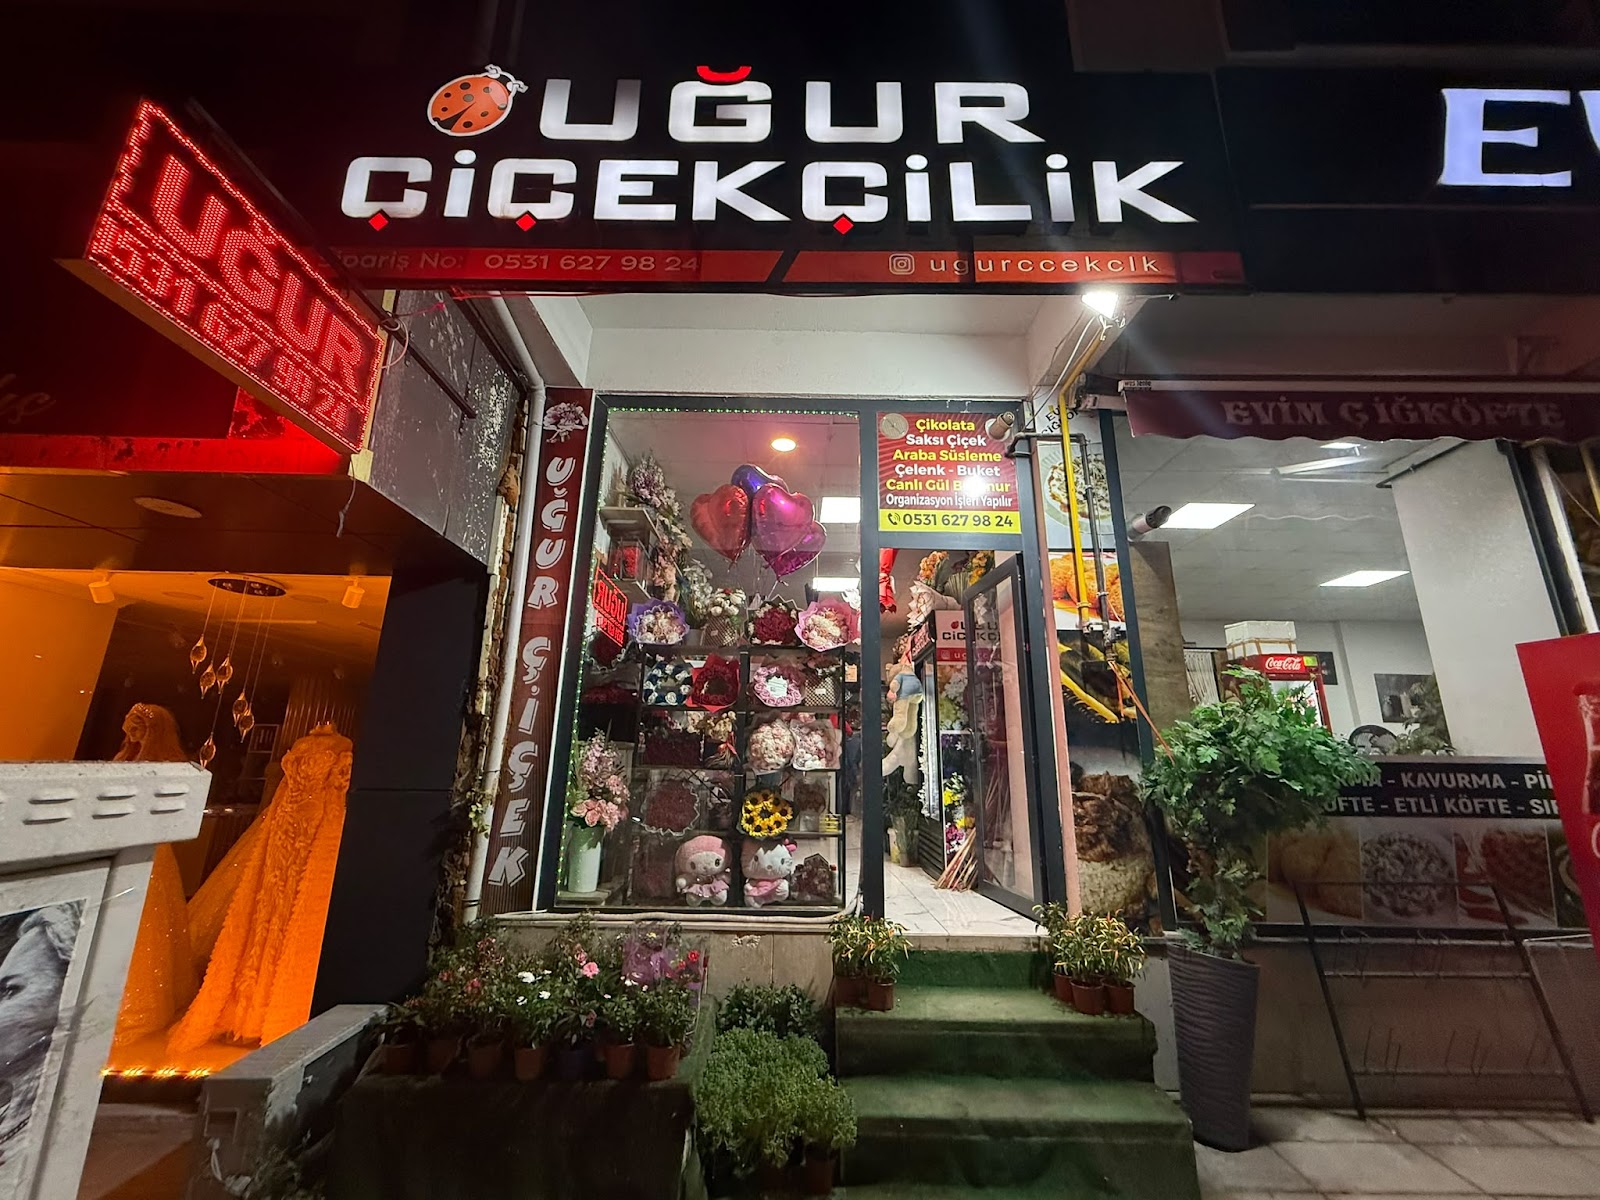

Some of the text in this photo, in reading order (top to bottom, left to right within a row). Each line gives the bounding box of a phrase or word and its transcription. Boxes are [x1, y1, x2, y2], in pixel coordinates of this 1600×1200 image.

[539, 65, 1046, 144] UĞUR
[1437, 87, 1600, 188] E
[341, 149, 1198, 234] ÇİÇEKÇİLİK
[484, 255, 549, 272] 0531
[559, 256, 610, 273] 627
[620, 256, 657, 273] 98
[664, 257, 702, 273] 24
[929, 255, 1160, 276] ugurccekclk
[152, 154, 364, 394] UĞUR
[314, 387, 349, 432] 24
[1220, 394, 1331, 426] EVİM
[915, 419, 976, 432] Çikolata
[906, 434, 987, 449] Saksı Çiçek
[892, 449, 1002, 462] Araba Süsleme
[895, 464, 946, 477] Çelenk
[957, 465, 1001, 476] Buket
[886, 479, 923, 491] Canlı
[925, 480, 950, 491] Gül
[886, 494, 953, 507] Organizasyon
[981, 494, 1013, 509] Yapılır
[903, 513, 1013, 527] 0531 627 98 24
[1401, 772, 1506, 789] KAVURMA
[1395, 794, 1441, 814] ETLİ
[1445, 797, 1512, 815] KÖFTE
